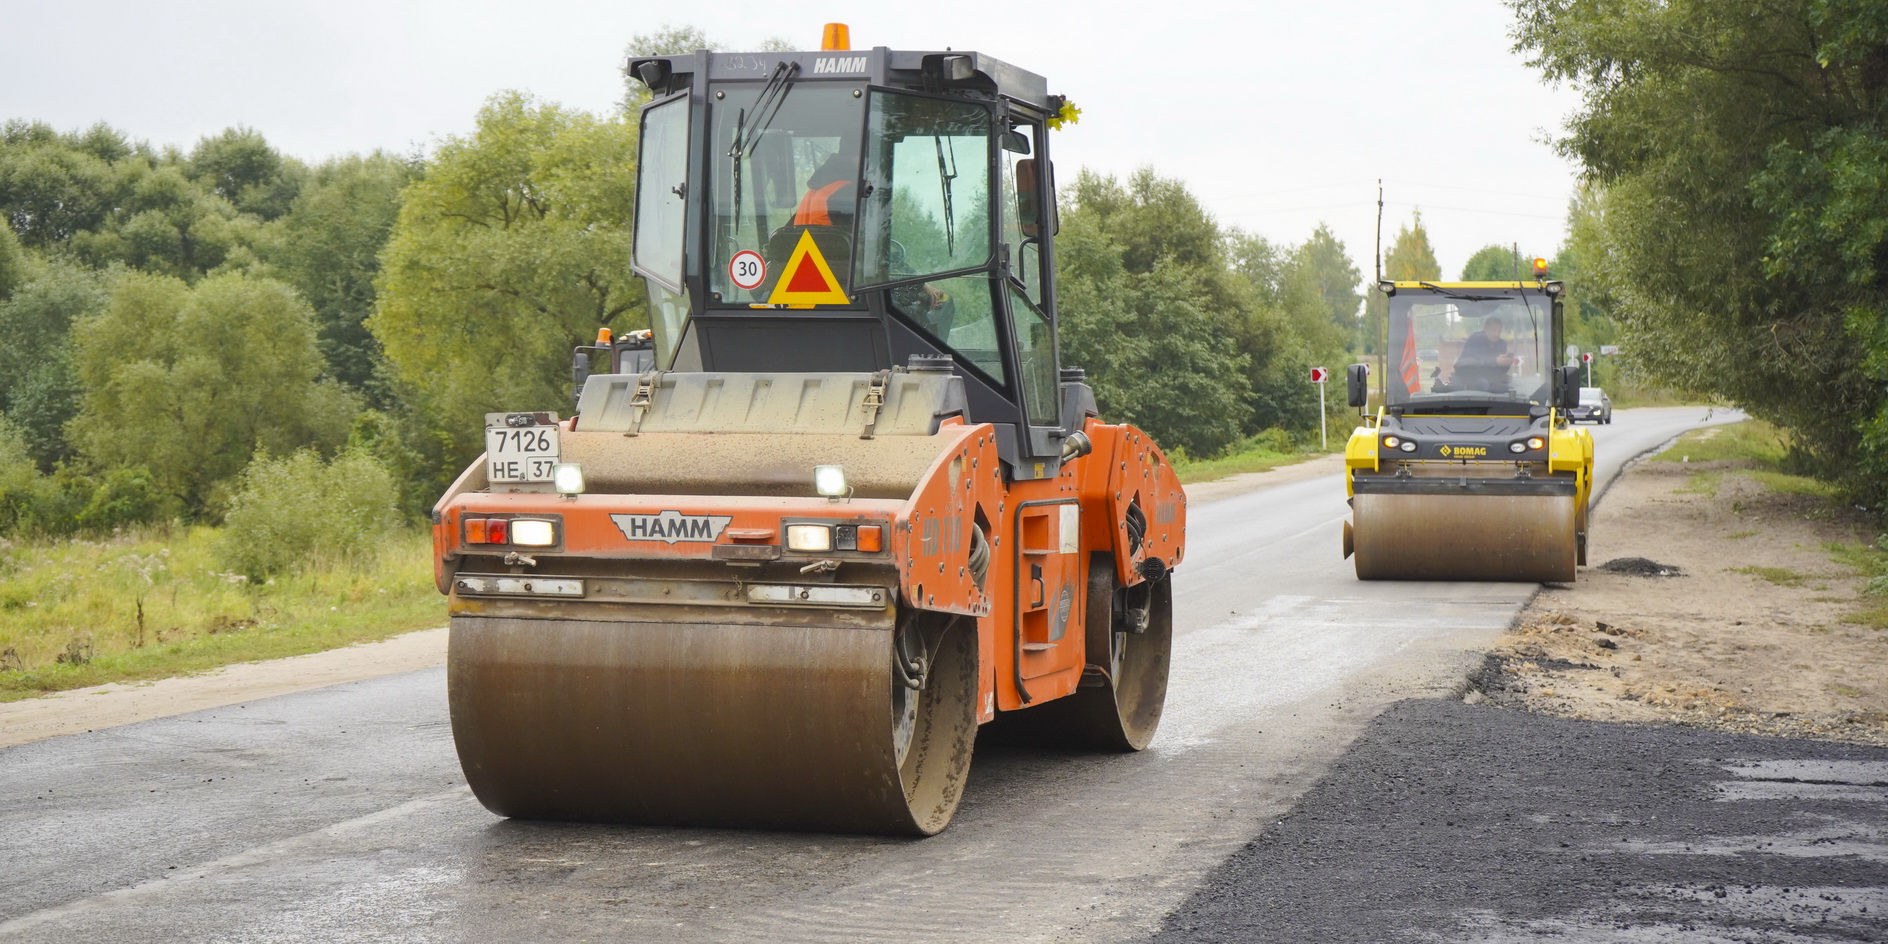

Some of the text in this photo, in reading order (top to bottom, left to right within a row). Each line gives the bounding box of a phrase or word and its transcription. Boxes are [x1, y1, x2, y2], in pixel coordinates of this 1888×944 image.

[813, 57, 867, 74] HAMM
[738, 261, 757, 277] 30
[495, 430, 550, 453] 7126
[1453, 446, 1487, 456] BOMAG
[533, 460, 554, 478] 37
[630, 517, 712, 539] HAMM
[922, 514, 962, 557] HD 110
